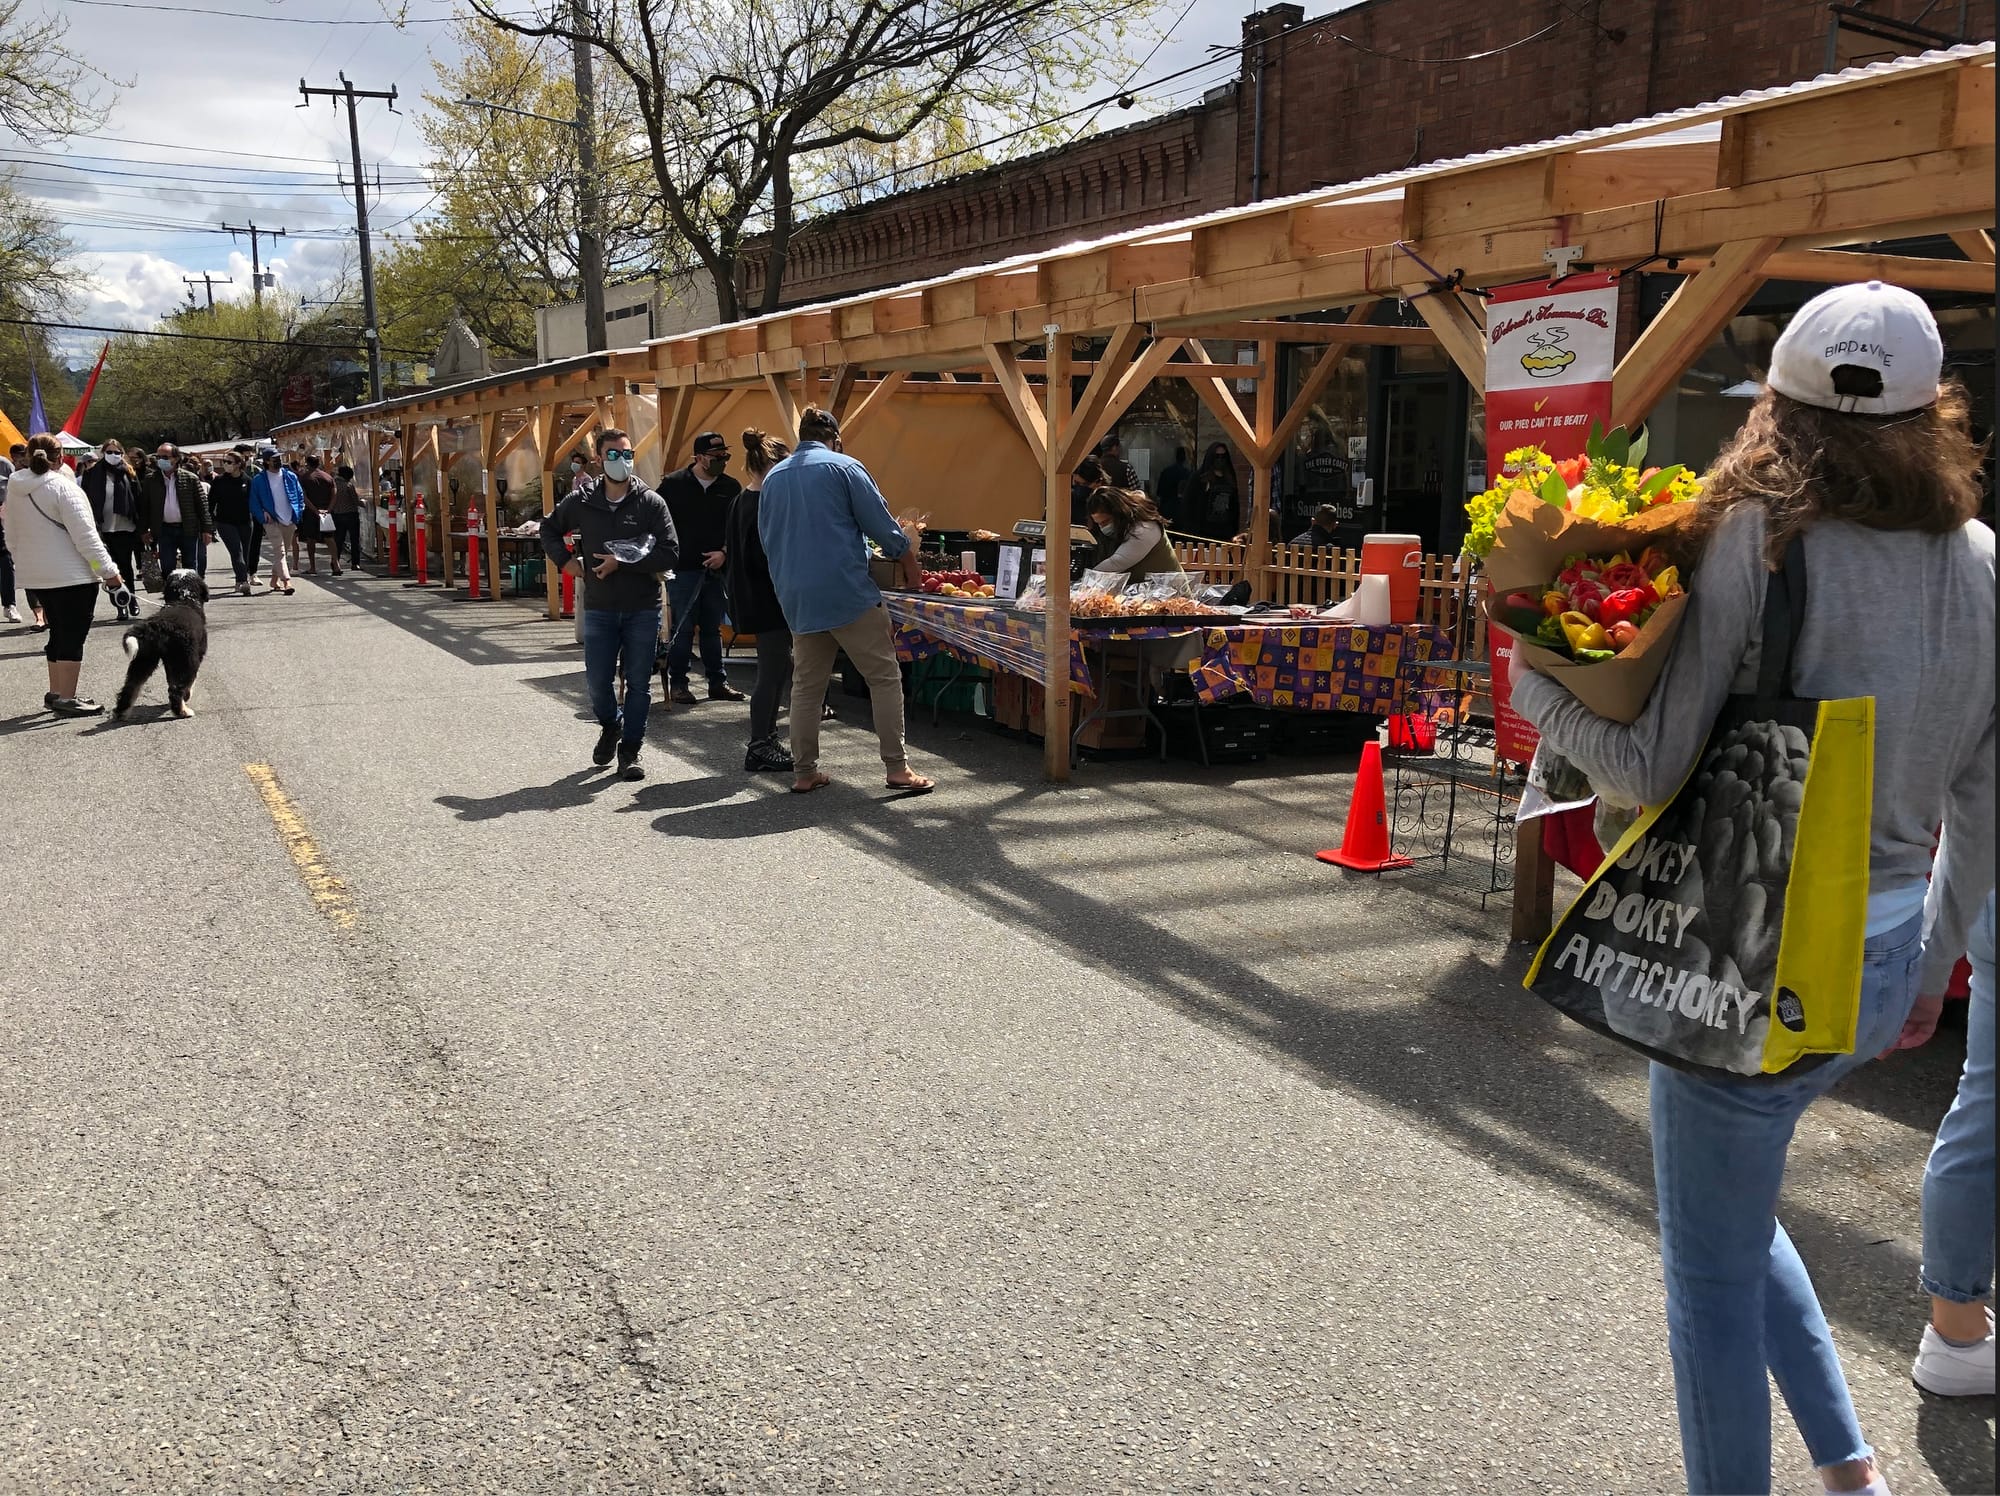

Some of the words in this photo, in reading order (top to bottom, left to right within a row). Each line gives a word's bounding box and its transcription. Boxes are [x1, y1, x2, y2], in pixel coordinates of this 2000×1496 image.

[1491, 309, 1534, 345] Deborah's
[1535, 303, 1586, 321] Homemade
[1585, 307, 1609, 329] Pies
[1499, 420, 1514, 431] OUR
[1514, 418, 1530, 430] PIES
[1530, 416, 1552, 429] CAN'T
[1553, 415, 1562, 427] BE
[1563, 413, 1589, 426] BEAT!
[1305, 459, 1315, 469] THE
[1315, 457, 1332, 466] OTHER
[1332, 458, 1349, 471] COAST
[1297, 501, 1353, 519] Sandhes
[1496, 647, 1513, 658] CRUS
[1583, 880, 1700, 949] DOKEY
